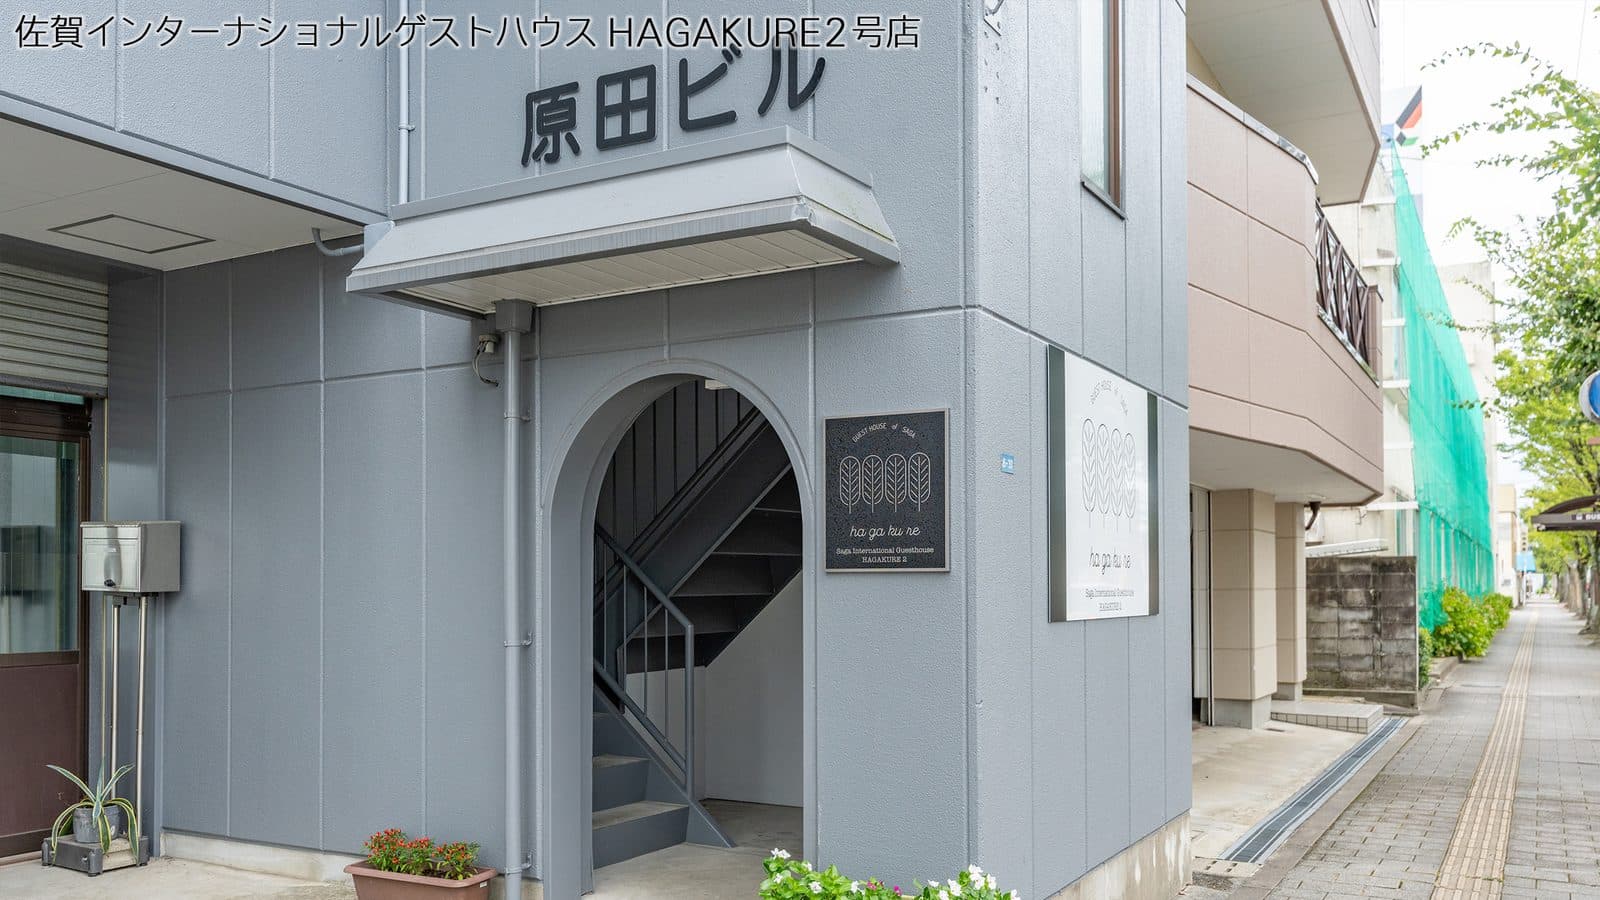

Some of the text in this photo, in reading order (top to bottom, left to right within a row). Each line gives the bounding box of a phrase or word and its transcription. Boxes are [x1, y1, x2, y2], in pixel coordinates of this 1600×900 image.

[521, 33, 826, 167] 原田ビル
[868, 422, 888, 432] HOUSE
[850, 525, 867, 537] ha
[868, 527, 886, 541] ga
[836, 546, 935, 556] Saga International Guesthouse
